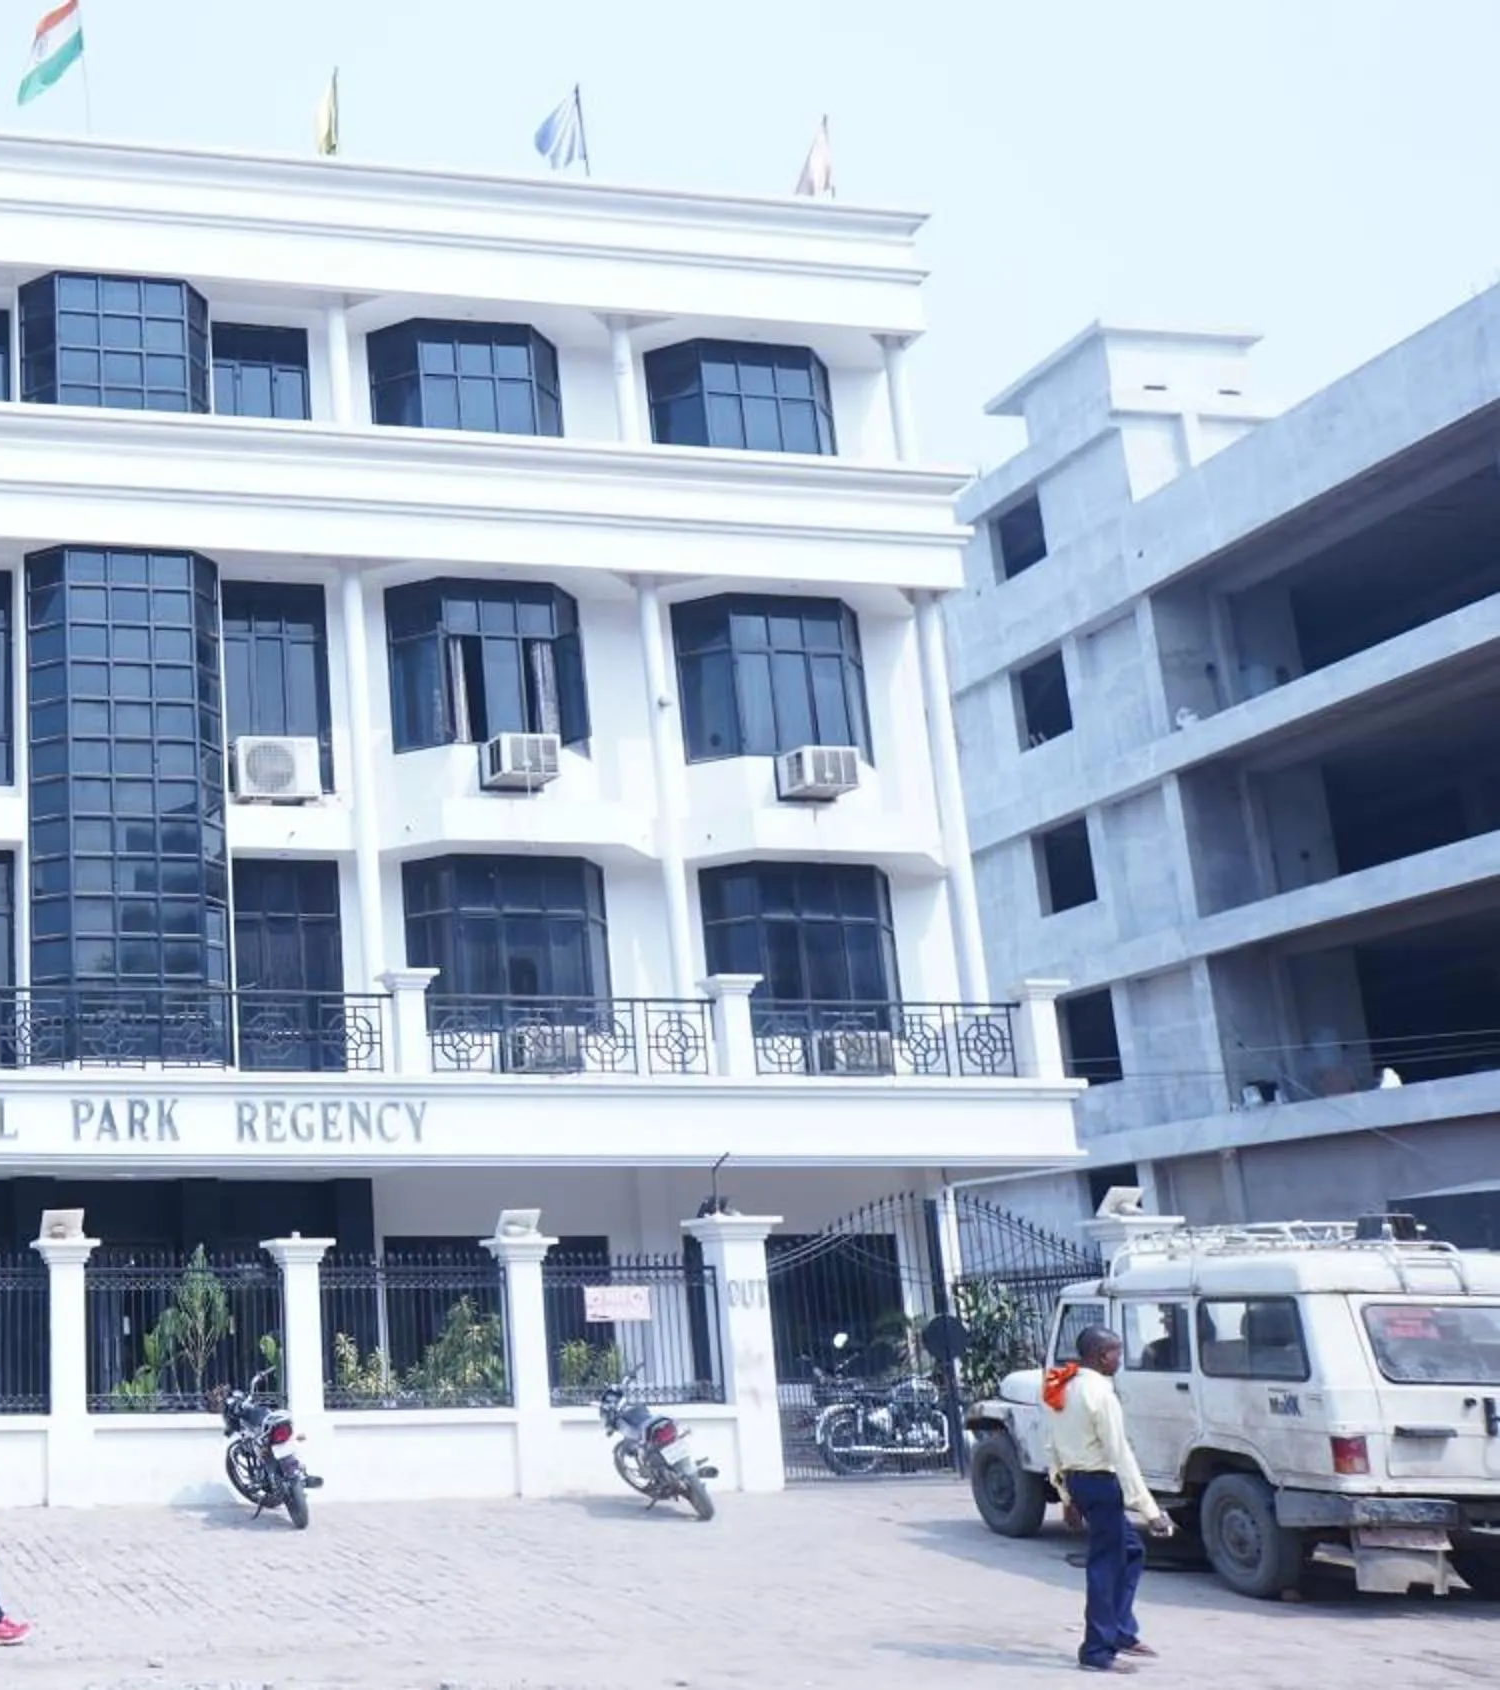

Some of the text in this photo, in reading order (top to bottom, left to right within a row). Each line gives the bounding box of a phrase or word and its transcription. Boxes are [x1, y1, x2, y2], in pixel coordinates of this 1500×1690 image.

[70, 1098, 181, 1142] PARK
[235, 1100, 427, 1143] REGENCY
[727, 1279, 766, 1310] OUT
